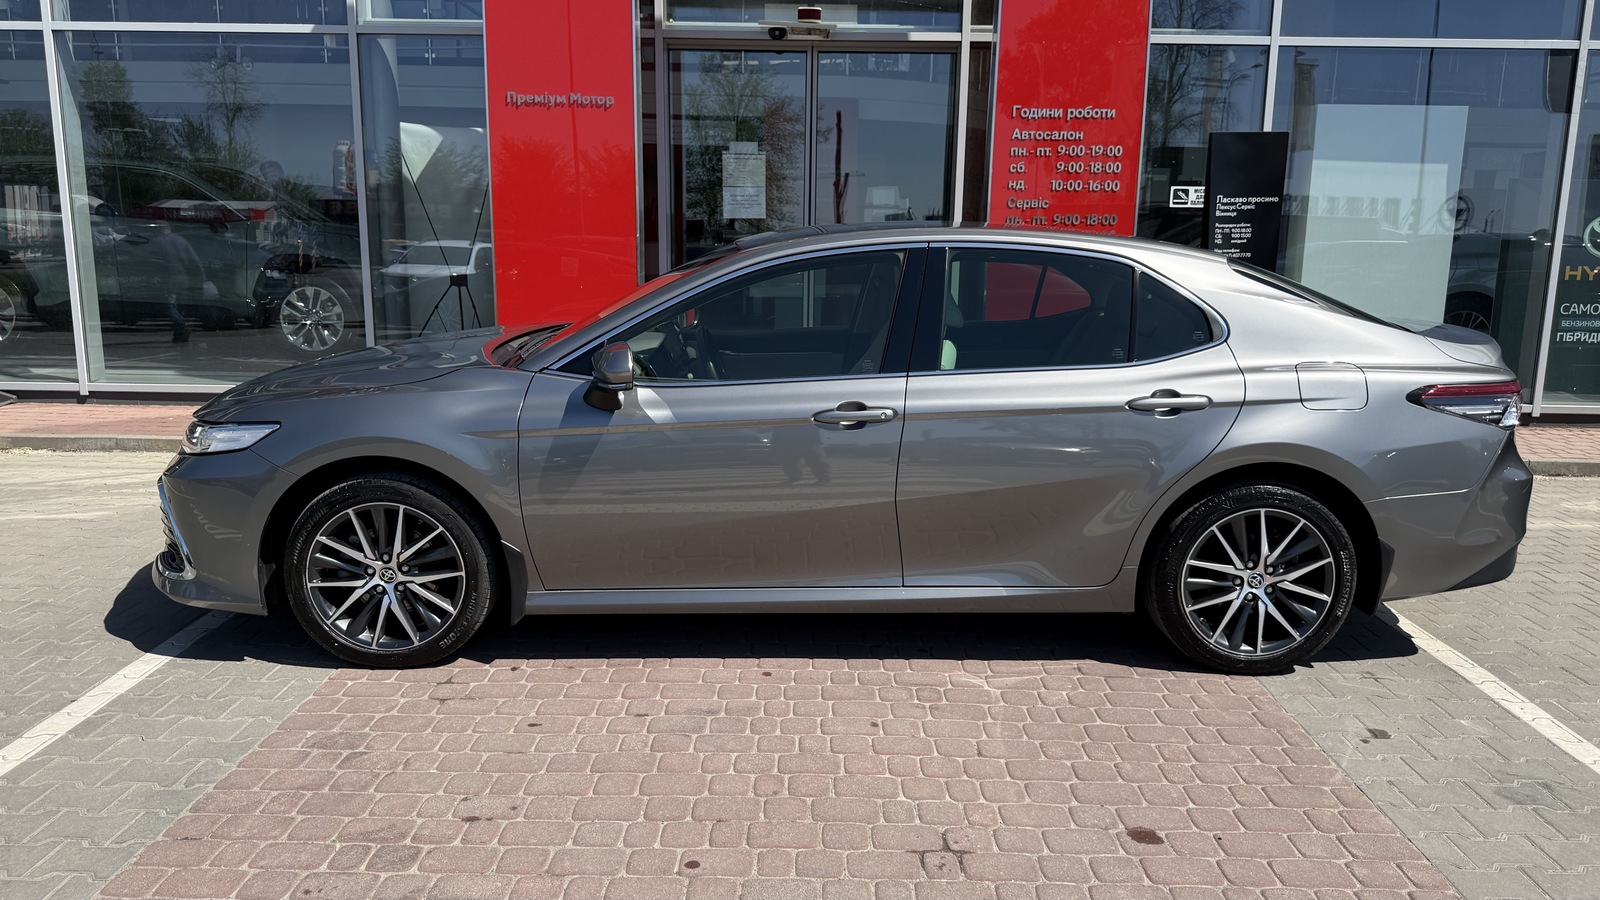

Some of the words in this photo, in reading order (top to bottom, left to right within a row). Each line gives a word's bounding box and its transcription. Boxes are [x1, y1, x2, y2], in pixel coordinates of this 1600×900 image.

[506, 91, 567, 106] Преміум
[569, 92, 615, 108] Мотор
[1012, 105, 1063, 120] Години
[1067, 105, 1116, 121] роботи
[1012, 128, 1084, 140] Автосалон
[1057, 145, 1123, 157] 9:00-19:00
[1009, 161, 1028, 173] сб.
[1056, 162, 1122, 174] 9:00-18:00
[1008, 180, 1028, 191] нд.
[1050, 179, 1121, 191] 10:00-16:00
[1007, 197, 1049, 210] Сервіс
[1216, 195, 1247, 203] Ласкаво
[1248, 196, 1279, 204] просимо
[1216, 203, 1236, 211] Лексус
[1236, 203, 1256, 211] Сервіс
[1053, 213, 1118, 226] 9:00-18:00
[1560, 303, 1600, 315] САМО
